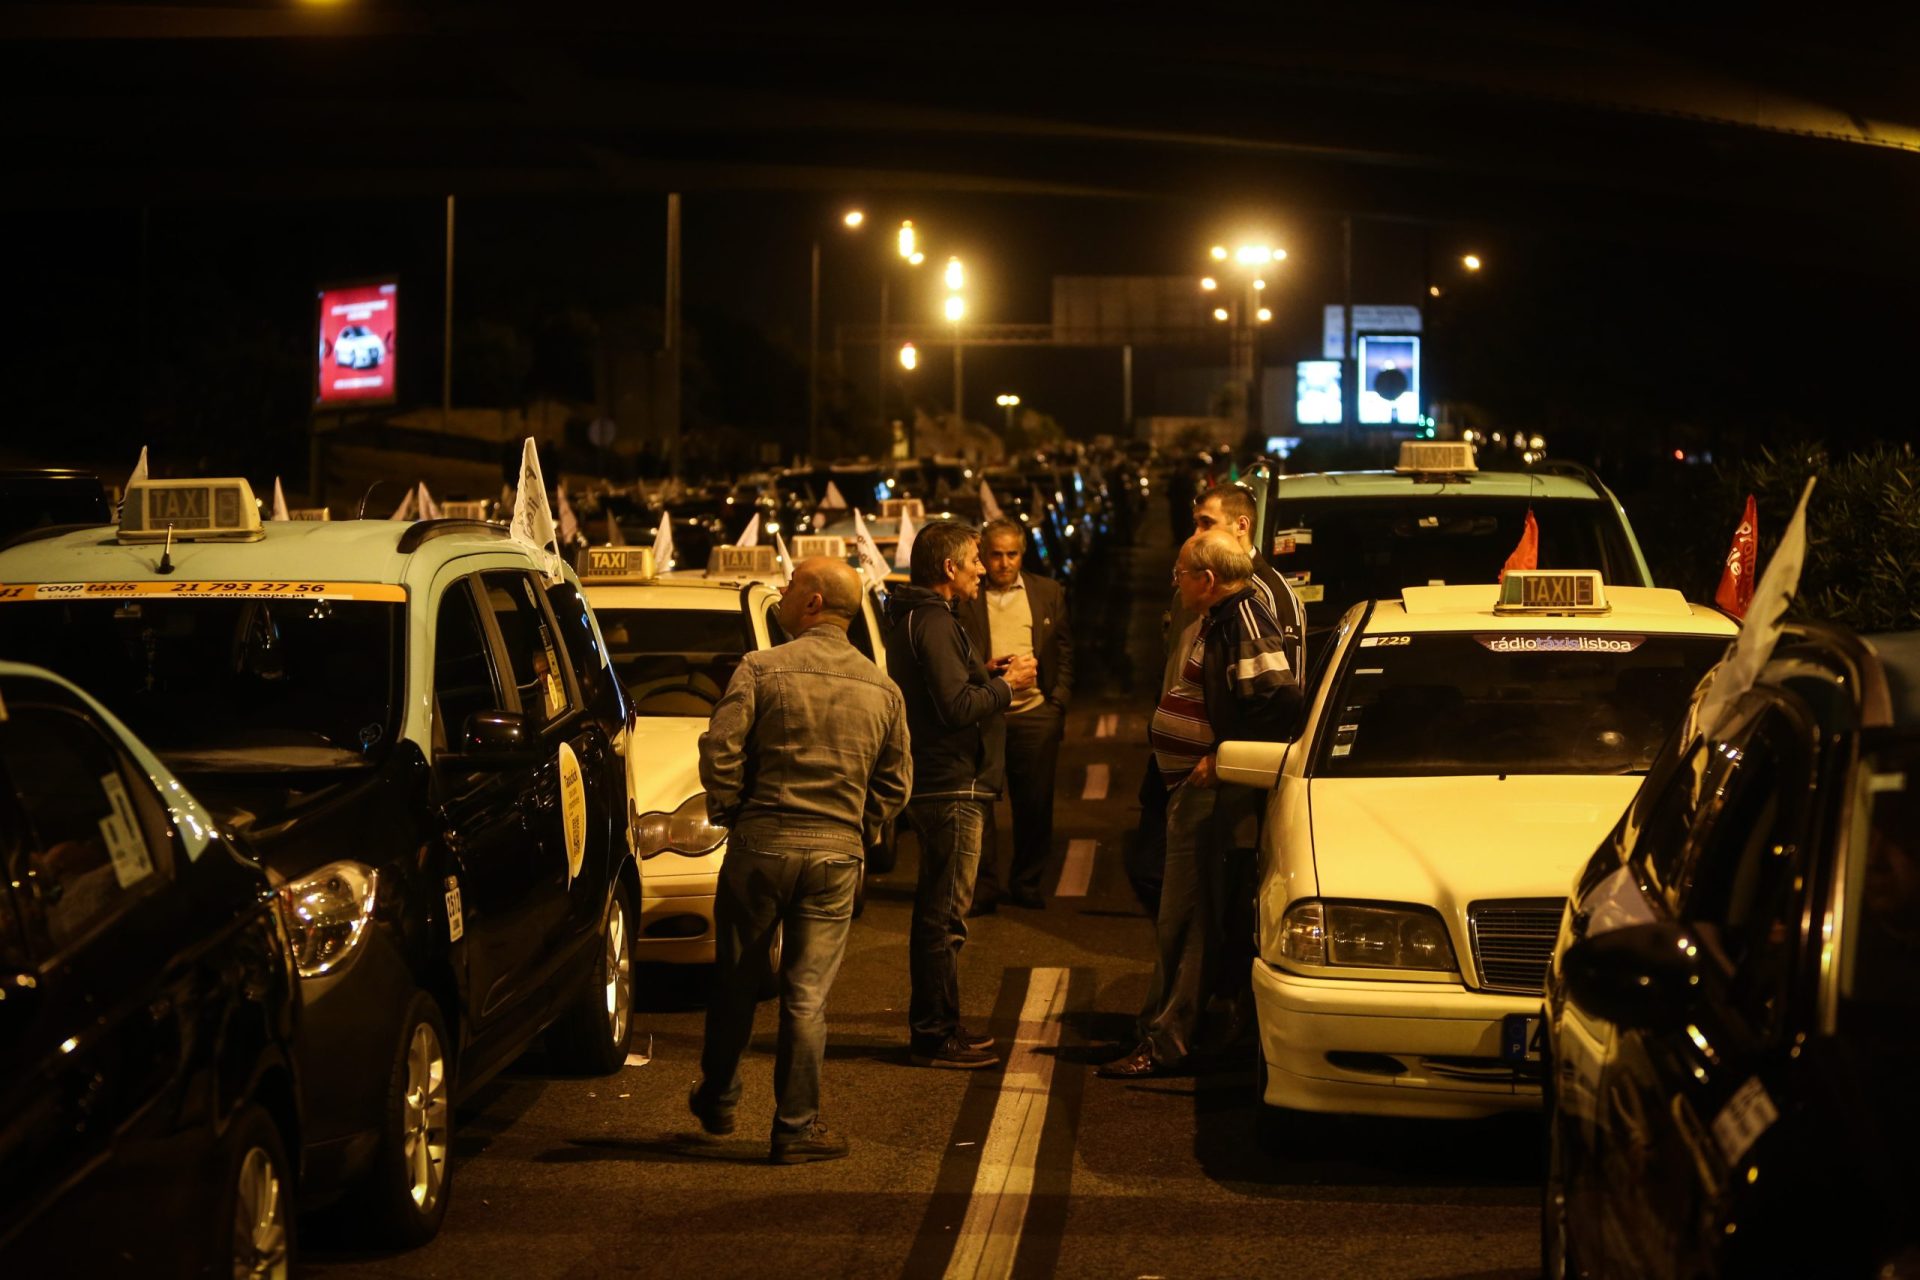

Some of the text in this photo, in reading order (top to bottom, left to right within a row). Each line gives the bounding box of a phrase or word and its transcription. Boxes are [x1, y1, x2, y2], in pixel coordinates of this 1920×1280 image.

[151, 489, 208, 518] TAXI
[591, 552, 626, 569] TAXI
[723, 551, 754, 568] TAXI
[37, 583, 84, 593] coop
[170, 583, 326, 593] 21 793 27 56
[1526, 577, 1572, 602] TAXI
[1377, 635, 1411, 647] 729
